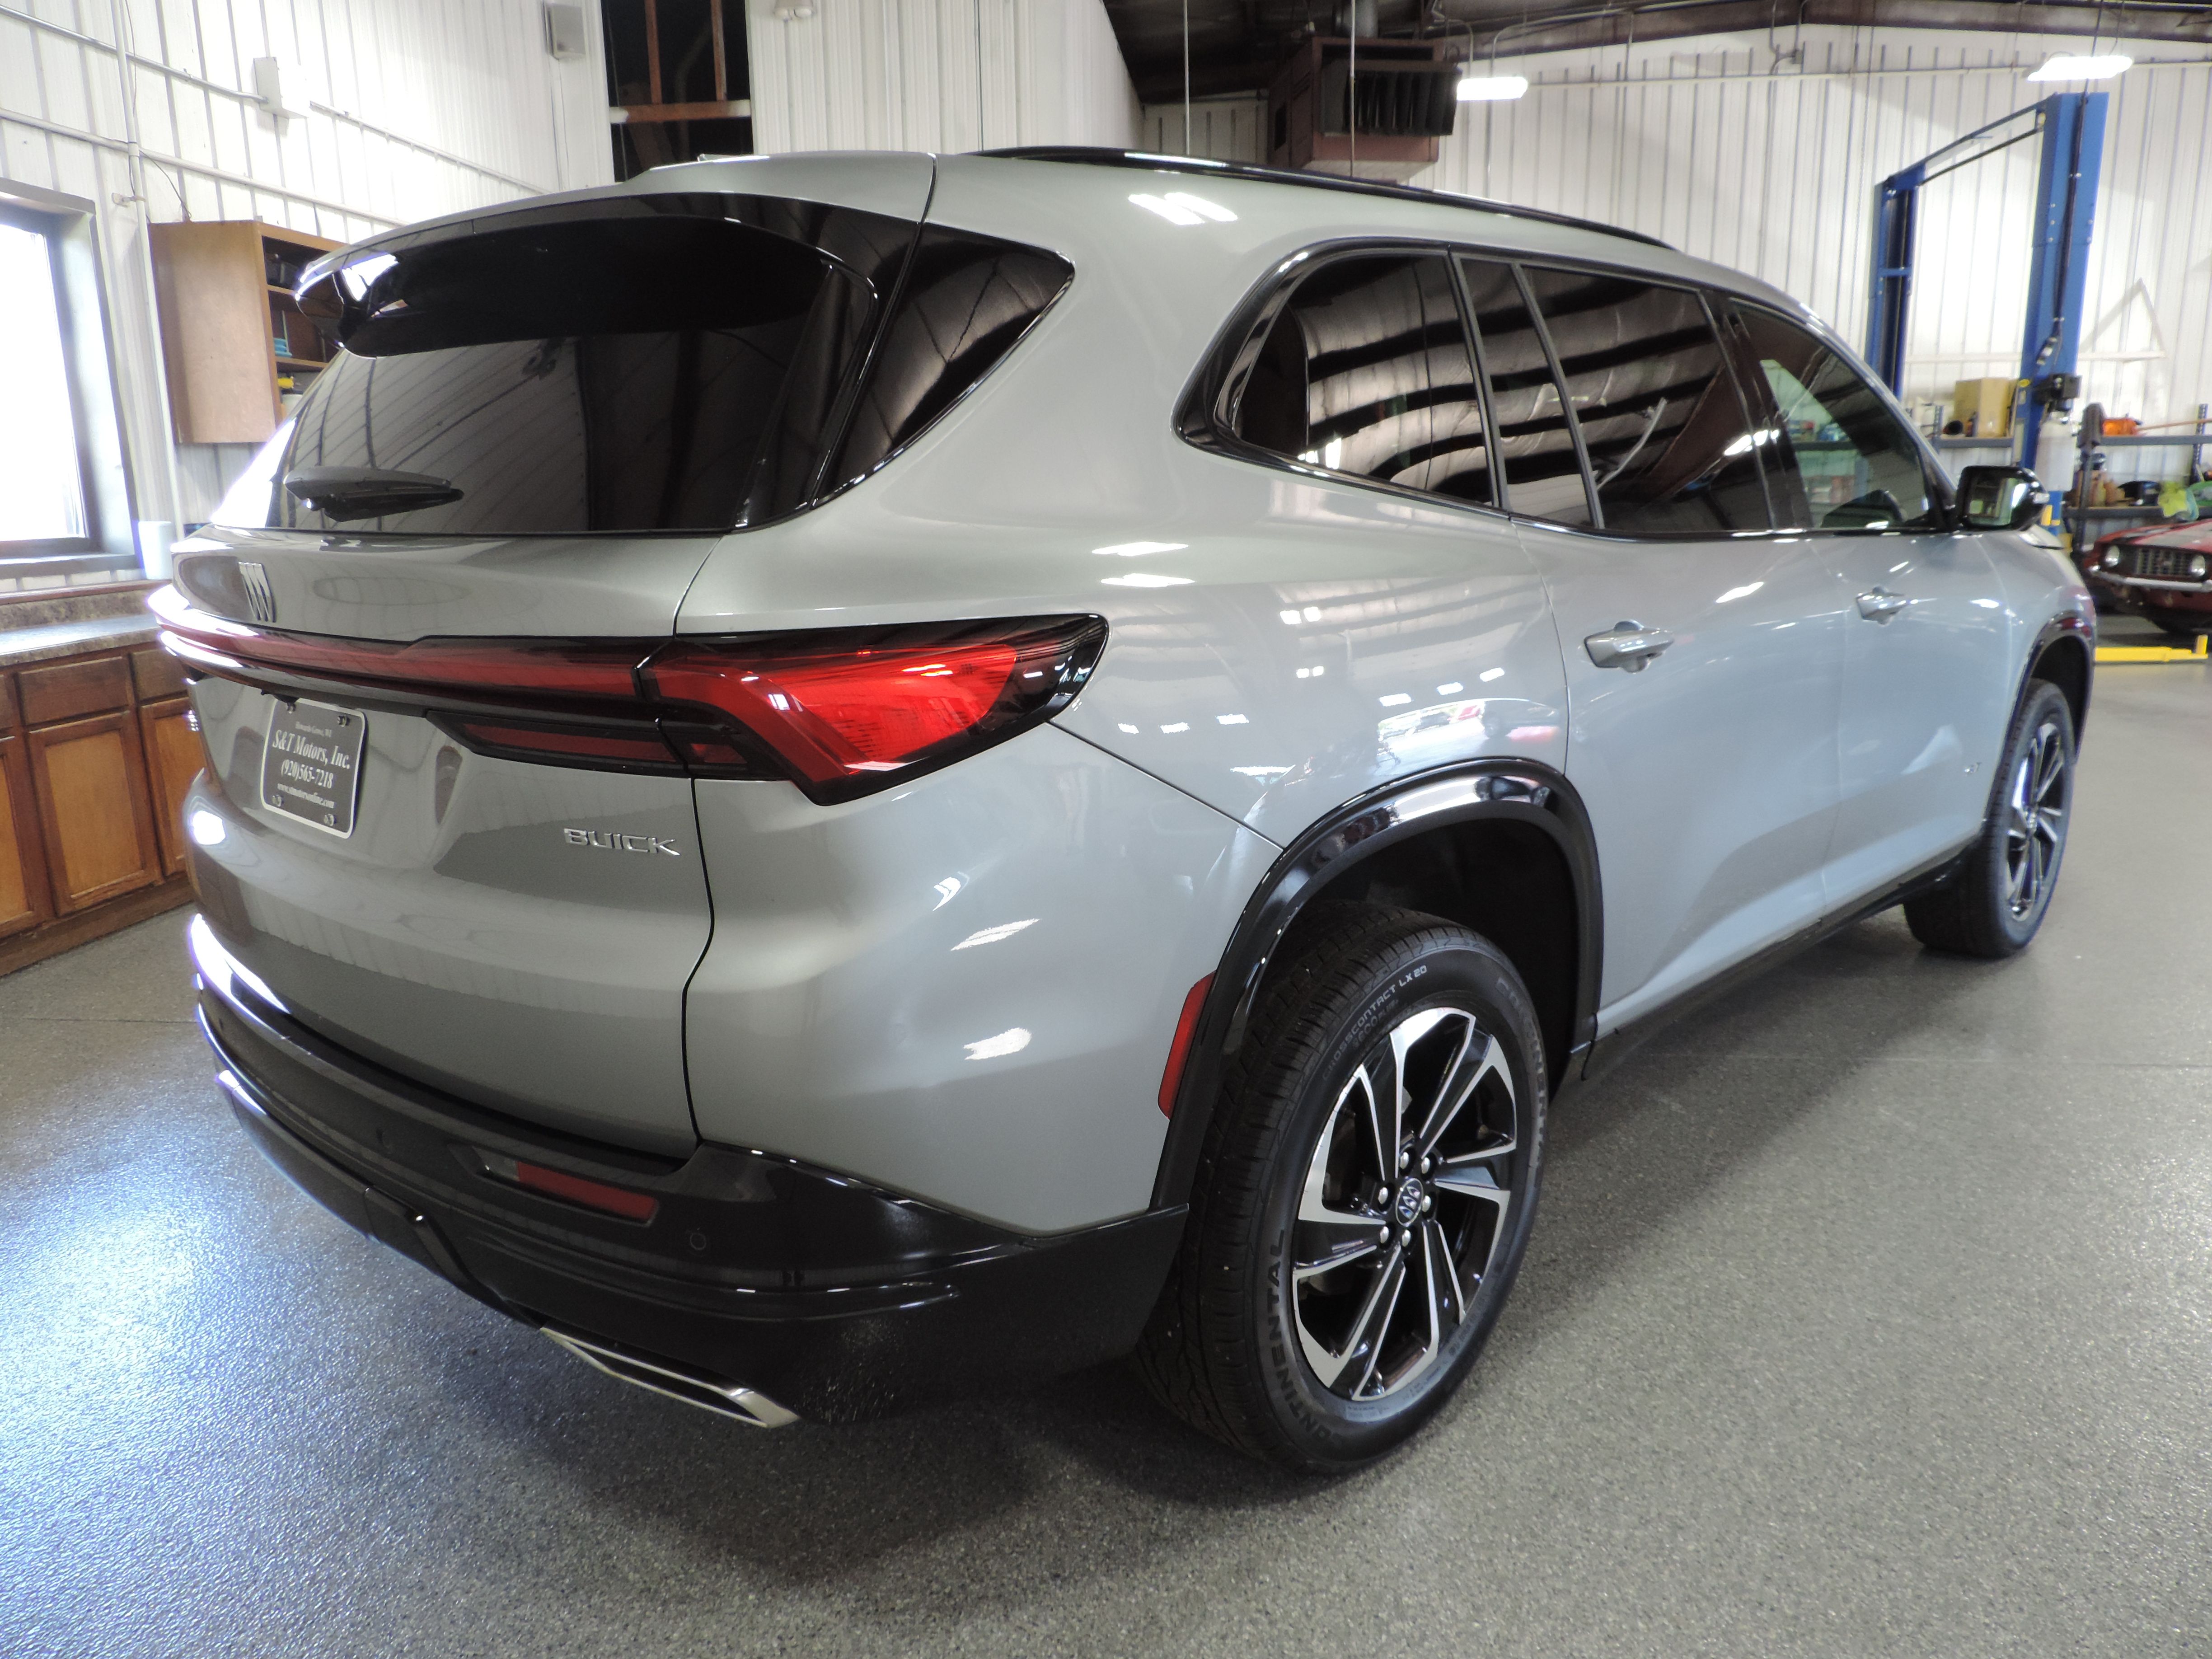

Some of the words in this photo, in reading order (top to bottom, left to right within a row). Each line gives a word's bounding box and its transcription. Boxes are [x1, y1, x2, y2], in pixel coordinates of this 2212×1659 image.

[272, 729, 295, 751] S&T
[293, 735, 328, 766] Motors,
[331, 745, 350, 769] Inc.
[564, 828, 680, 856] BUICK
